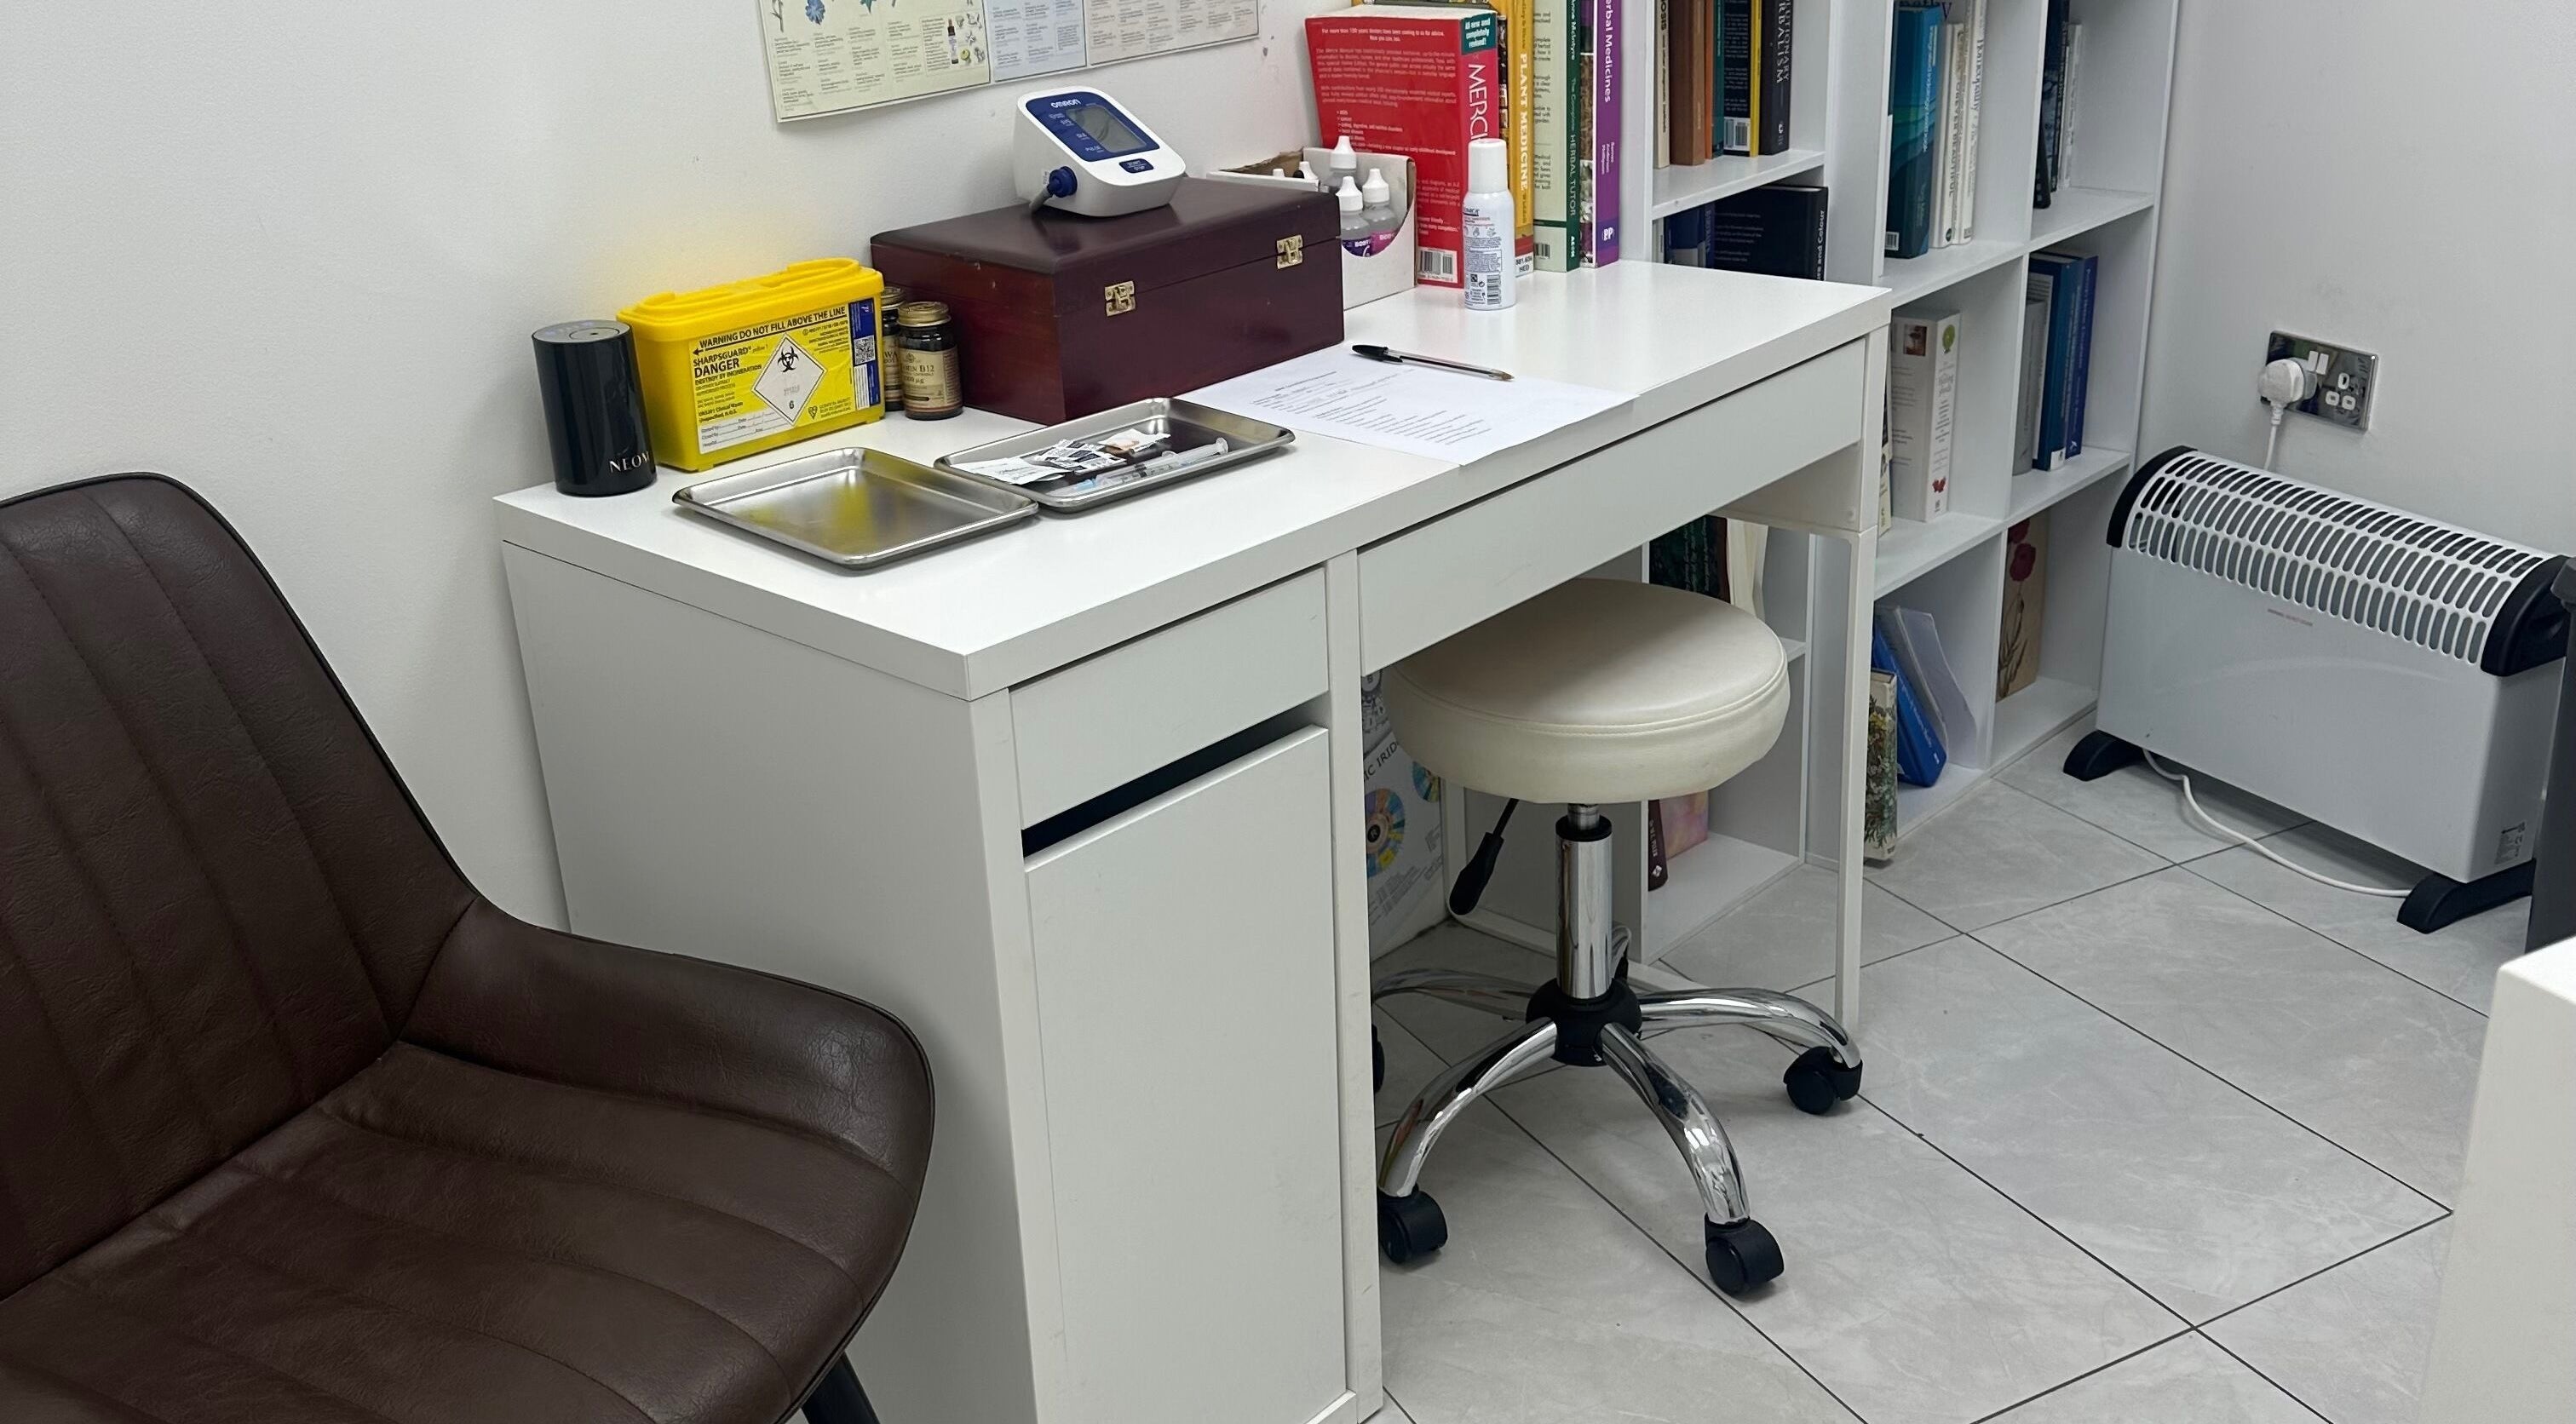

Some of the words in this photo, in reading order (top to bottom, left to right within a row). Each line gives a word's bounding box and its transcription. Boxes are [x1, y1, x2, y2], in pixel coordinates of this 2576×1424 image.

[1520, 53, 1528, 107] PLANT
[1604, 34, 1613, 103] Medicines
[1520, 111, 1528, 192] MEDICINE
[699, 331, 739, 348] WARNING
[739, 328, 752, 340] DO
[753, 324, 769, 337] NOT
[770, 319, 785, 332] FILL
[787, 313, 814, 329] ABOVE
[814, 308, 829, 321] THE
[829, 306, 846, 318] LINE
[694, 358, 740, 379] DANGER
